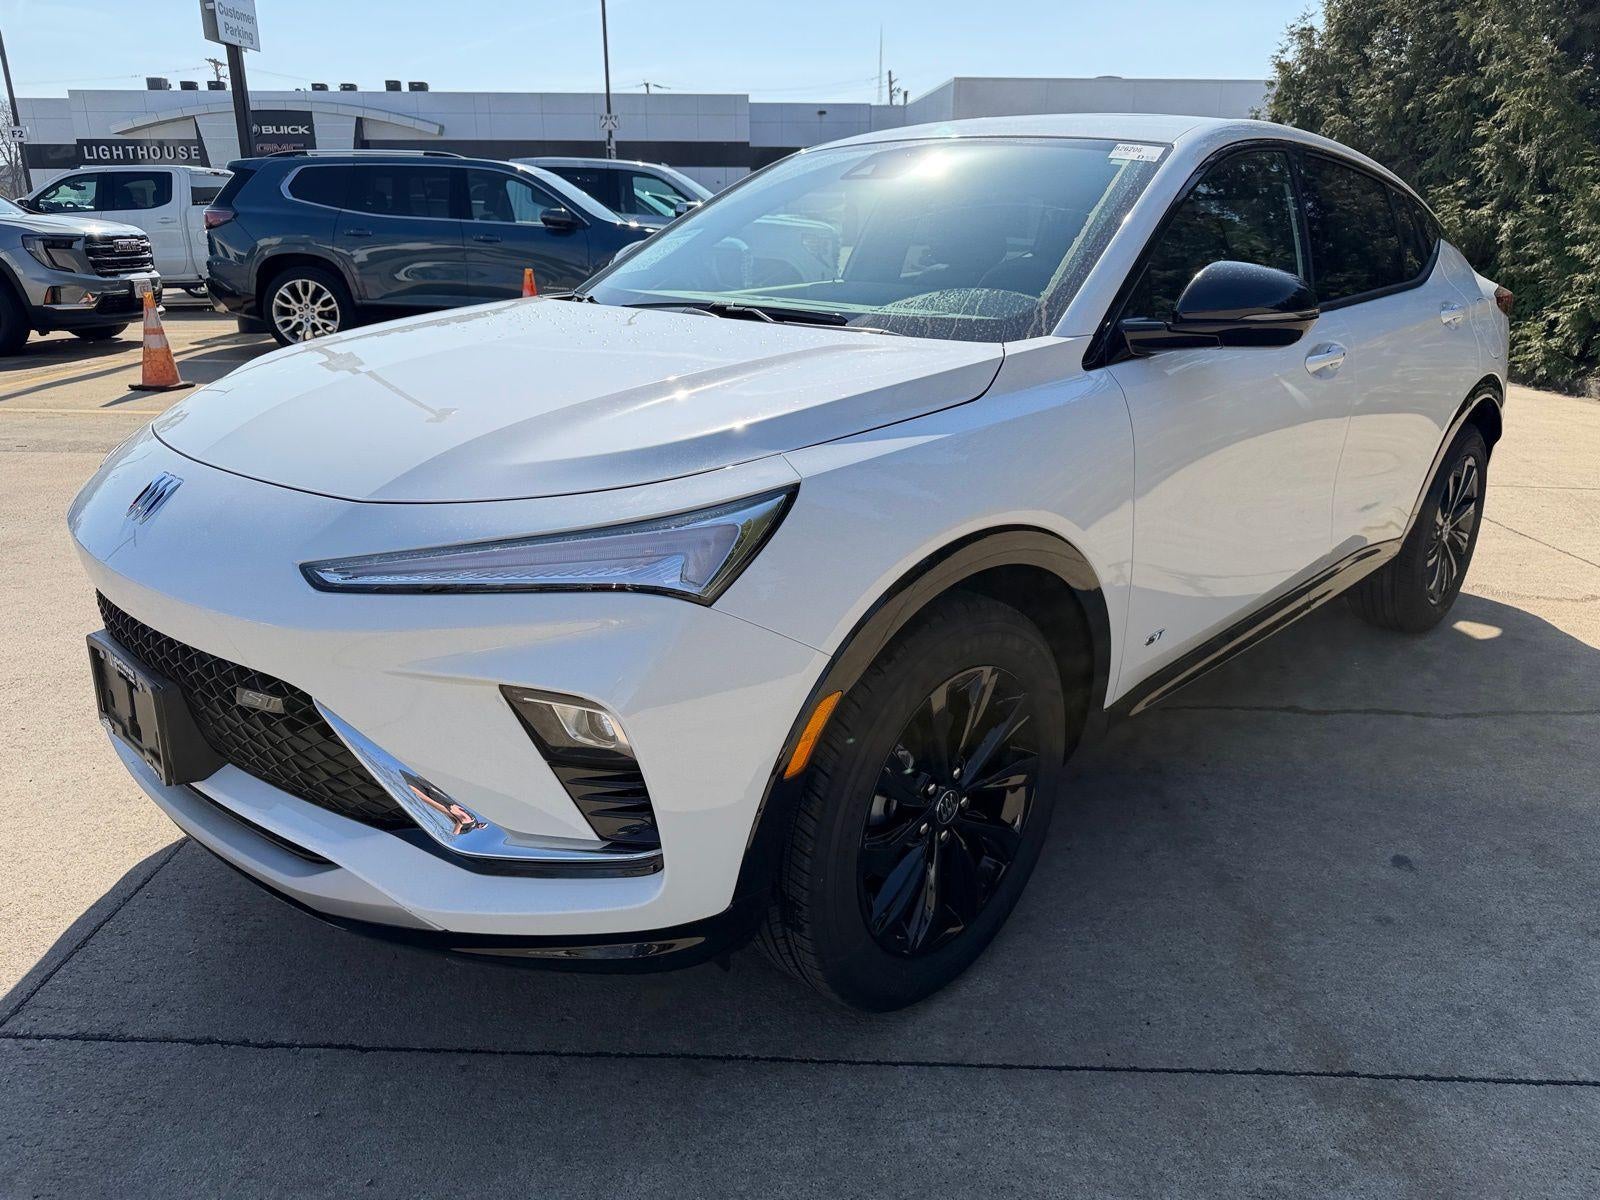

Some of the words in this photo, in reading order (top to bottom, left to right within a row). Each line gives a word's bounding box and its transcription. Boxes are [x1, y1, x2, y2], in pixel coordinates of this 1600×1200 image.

[217, 2, 255, 25] Customer
[224, 22, 253, 45] Parking
[11, 130, 24, 138] F2
[261, 125, 310, 135] BUICK
[83, 145, 201, 160] LIGHTHOUSE
[256, 143, 304, 153] GMC
[1143, 627, 1166, 647] ST
